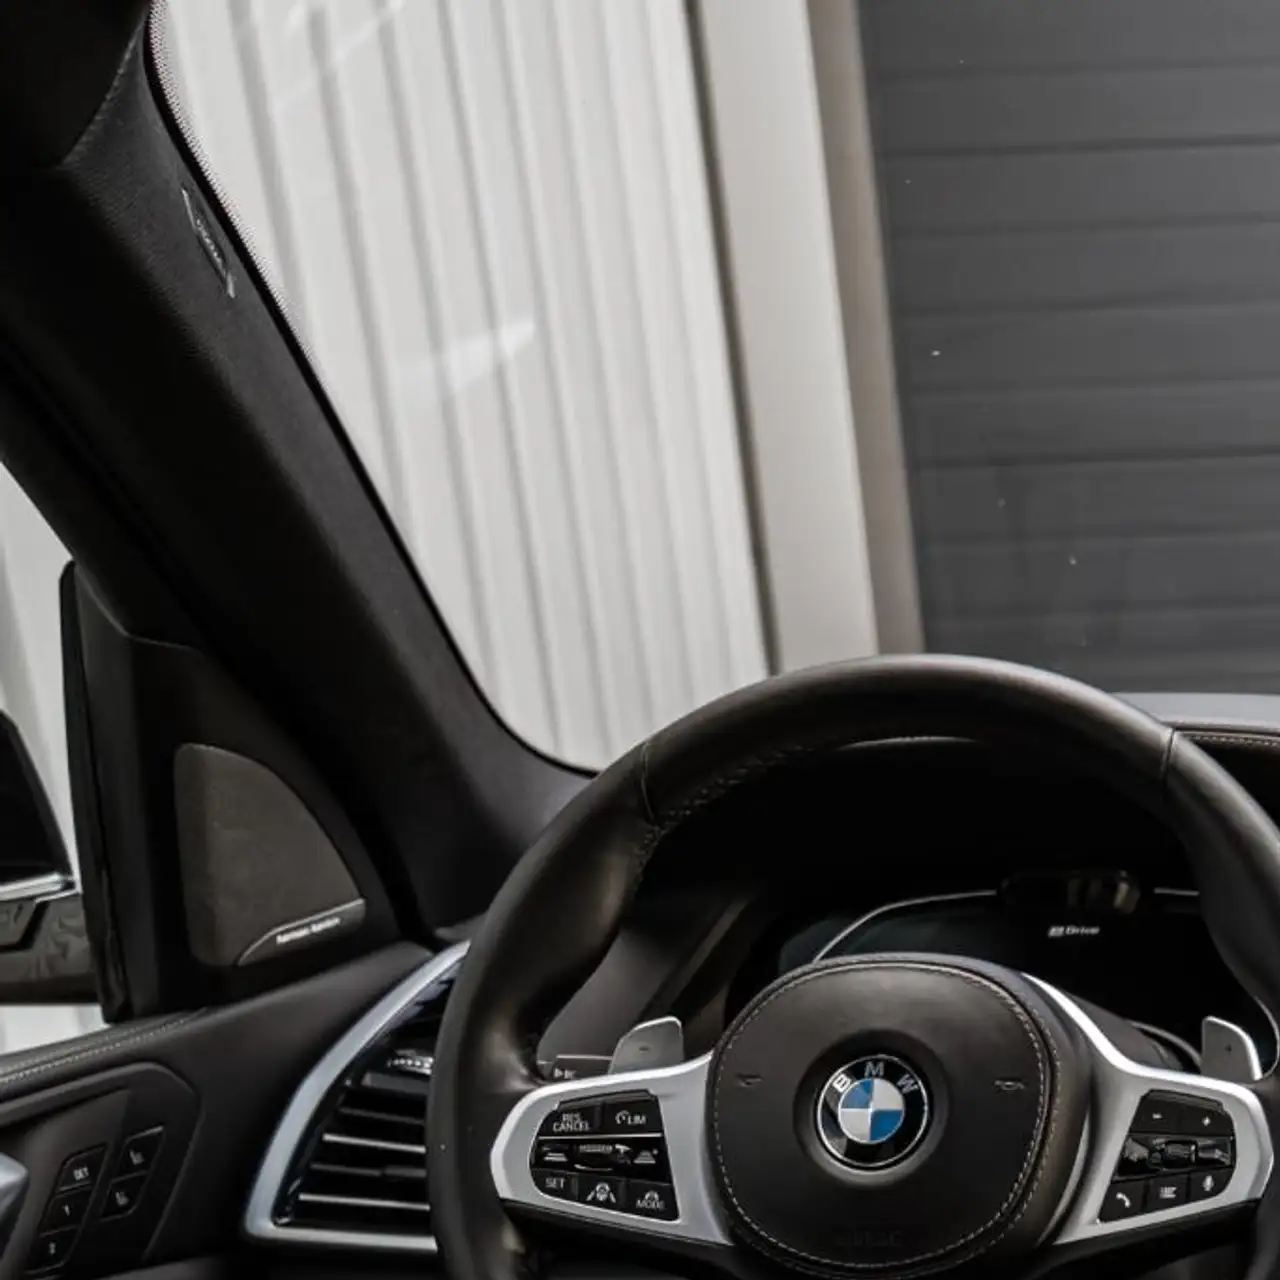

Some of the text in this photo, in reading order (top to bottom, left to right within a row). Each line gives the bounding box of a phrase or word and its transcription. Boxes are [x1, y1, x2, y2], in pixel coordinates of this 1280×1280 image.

[832, 1061, 919, 1094] BMW
[552, 1120, 589, 1132] CANCEL
[545, 1177, 566, 1188] SET
